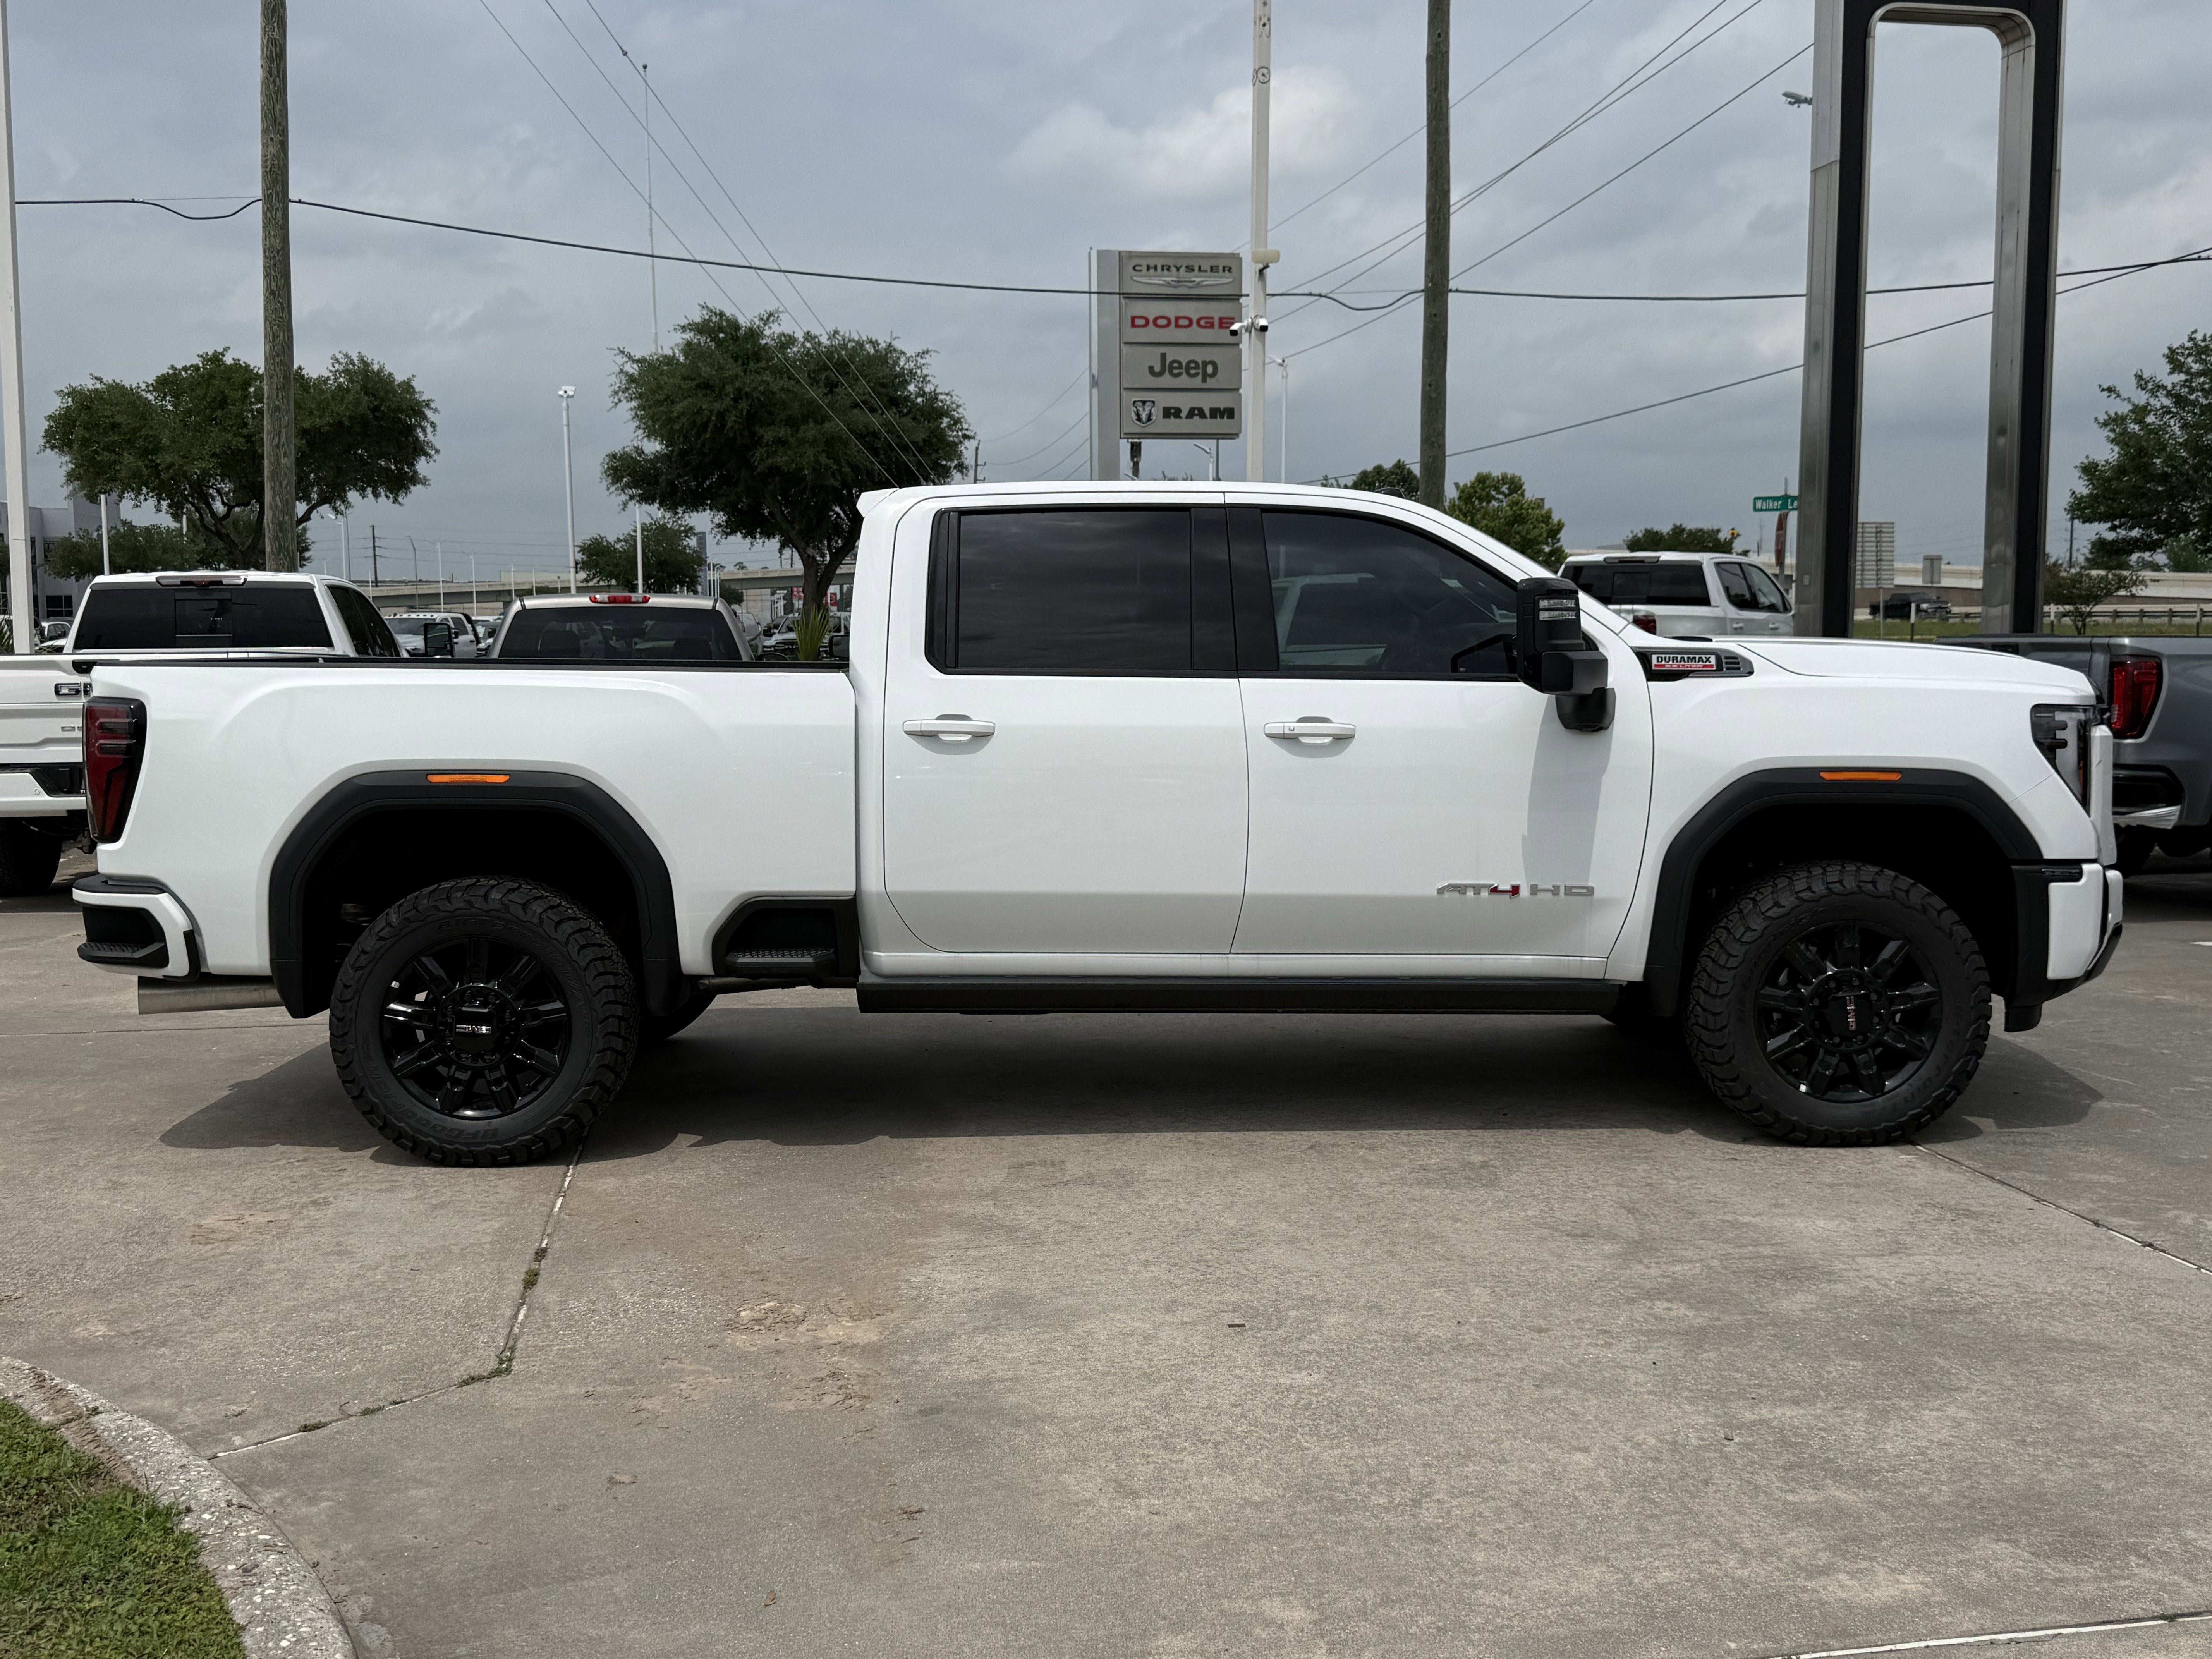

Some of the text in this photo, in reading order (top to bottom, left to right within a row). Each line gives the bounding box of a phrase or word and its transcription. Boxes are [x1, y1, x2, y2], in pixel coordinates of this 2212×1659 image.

[1132, 264, 1233, 273] CHRYSLER
[1130, 316, 1235, 329] DODGE
[1148, 352, 1218, 383] Jeep
[1163, 407, 1235, 419] RAM
[1755, 499, 1782, 510] Walker
[1436, 883, 1594, 899] AT4 HD
[1846, 996, 1856, 1031] GMC
[456, 1024, 491, 1034] GMC
